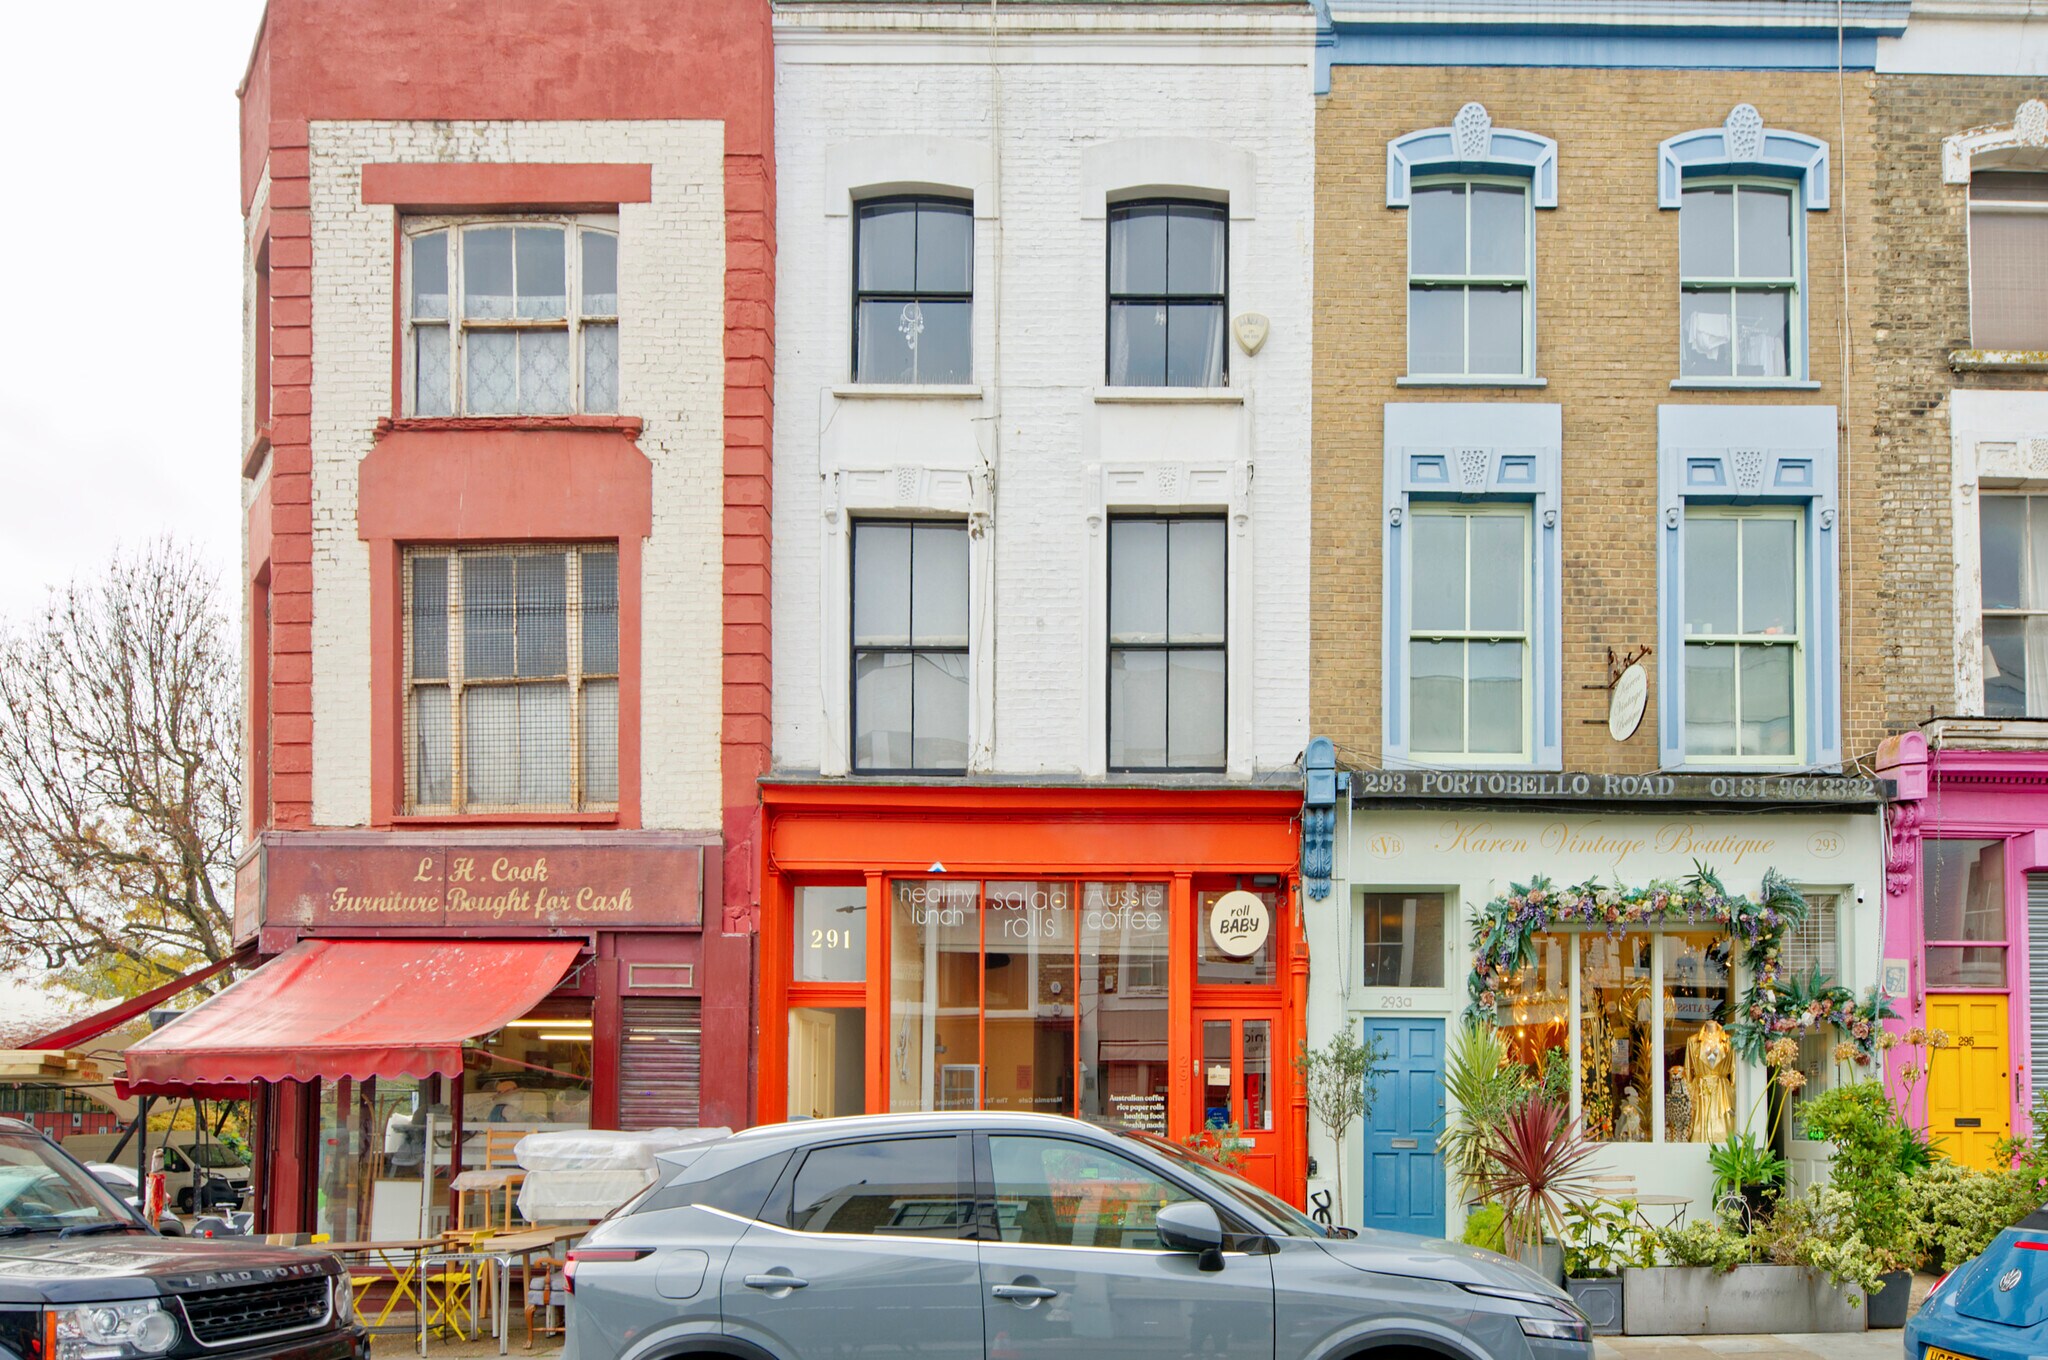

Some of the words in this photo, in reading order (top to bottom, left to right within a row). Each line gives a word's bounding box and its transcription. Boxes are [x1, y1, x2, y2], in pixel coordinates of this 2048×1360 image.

[1365, 773, 1406, 793] 293
[1421, 774, 1590, 795] PORTOBELLO
[1603, 775, 1675, 796] ROAD
[1710, 777, 1767, 798] 0181
[1370, 836, 1401, 855] KVB
[1434, 819, 1529, 854] Karen
[1540, 819, 1645, 867] Vintage
[1654, 822, 1775, 864] Boutique
[1815, 838, 1838, 852] 293
[491, 857, 549, 882] Cook
[329, 887, 440, 912] Furniture
[445, 887, 531, 920] Bought
[534, 887, 571, 919] for
[576, 887, 633, 912] Cash
[900, 881, 976, 907] healthy
[992, 882, 1067, 911] salad
[1087, 884, 1162, 907] Aussie
[911, 903, 964, 925] lunch
[1087, 906, 1162, 930] coffee
[1230, 905, 1250, 917] roll
[1004, 910, 1055, 937] rolls
[1219, 918, 1260, 934] BABY
[810, 928, 851, 949] 291
[1381, 996, 1412, 1009] 293a
[1958, 1036, 1974, 1047] 295
[1109, 1094, 1144, 1102] Australian
[1144, 1094, 1165, 1102] coffee
[1116, 1103, 1129, 1111] rice
[1129, 1104, 1149, 1112] paper
[1149, 1103, 1165, 1111] rolls
[1123, 1112, 1149, 1120] healthy
[1149, 1112, 1165, 1120] food
[185, 1271, 252, 1287] LAND
[262, 1262, 323, 1279] ROVER
